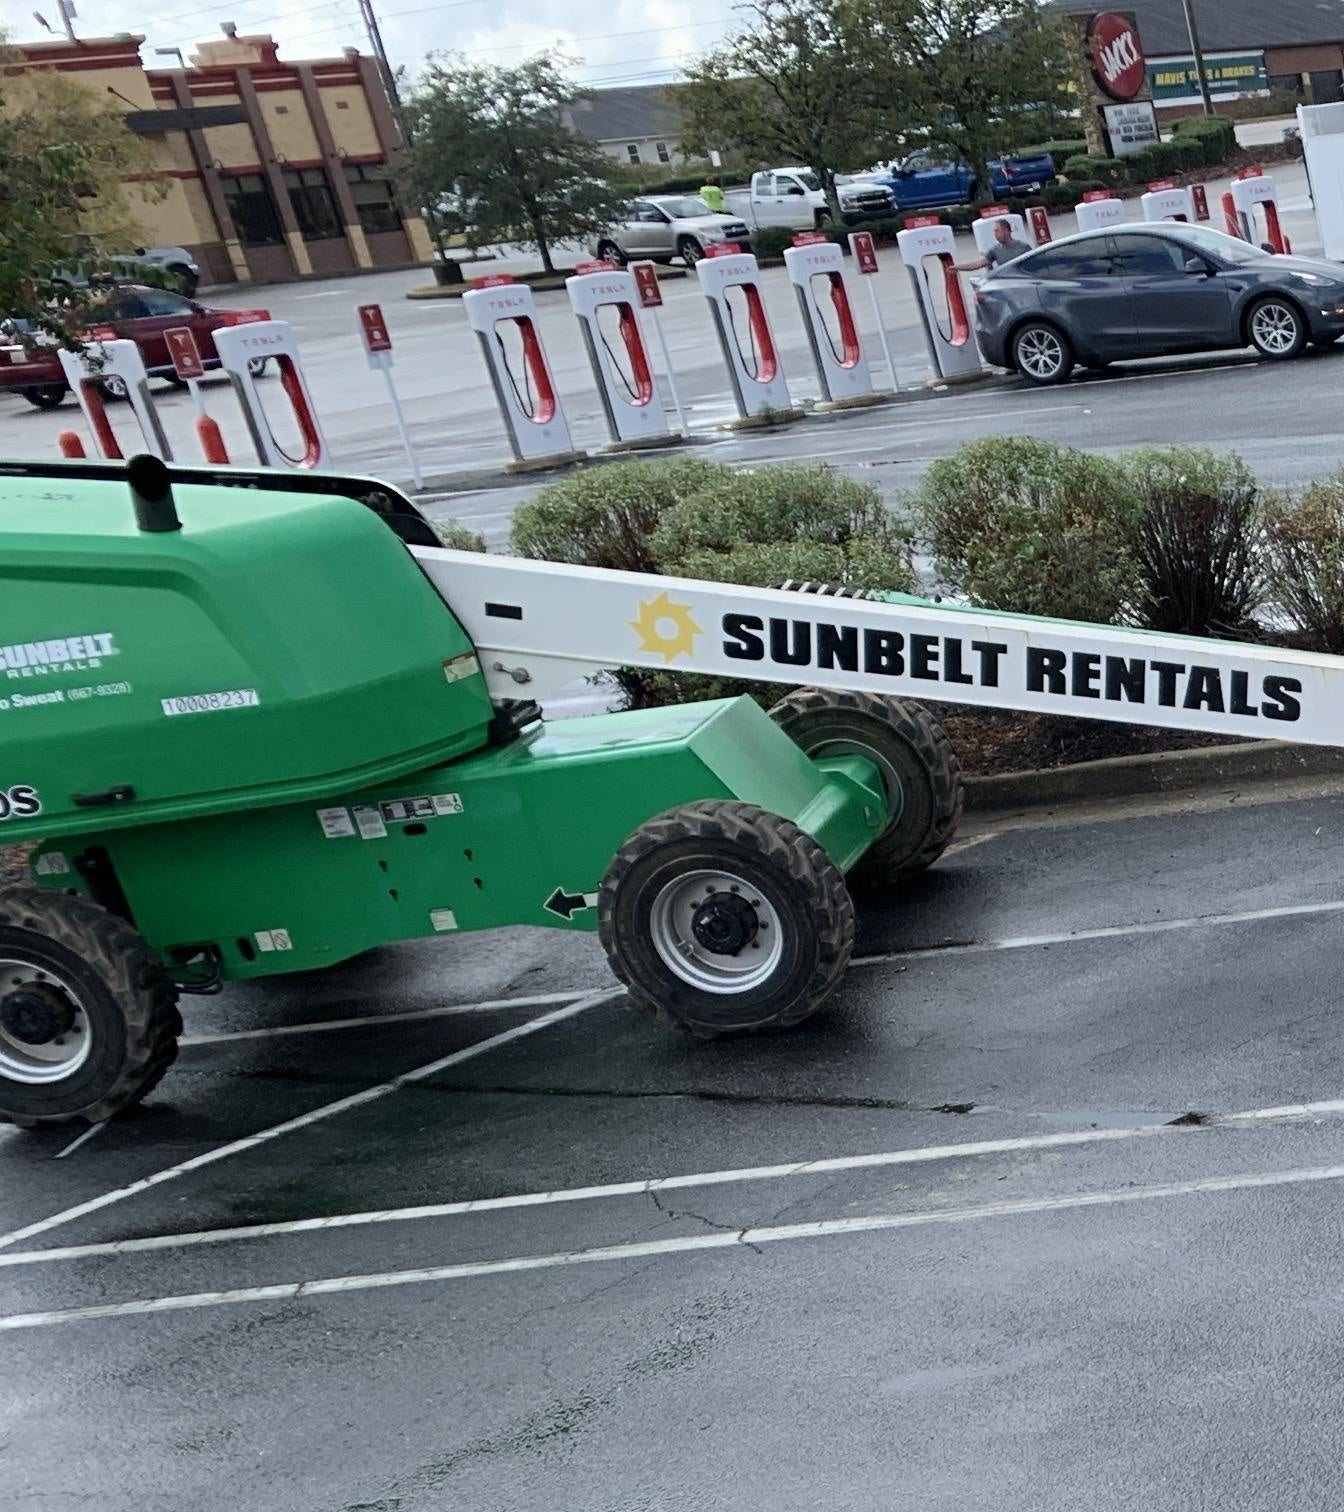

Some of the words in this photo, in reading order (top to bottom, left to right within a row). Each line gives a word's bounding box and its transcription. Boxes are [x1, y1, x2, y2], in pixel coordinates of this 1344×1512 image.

[6, 658, 101, 679] RENTALS
[722, 612, 1008, 688] SUNBELT
[1026, 645, 1303, 723] RENTALS
[11, 689, 65, 708] Sweat
[165, 690, 256, 714] 10008237
